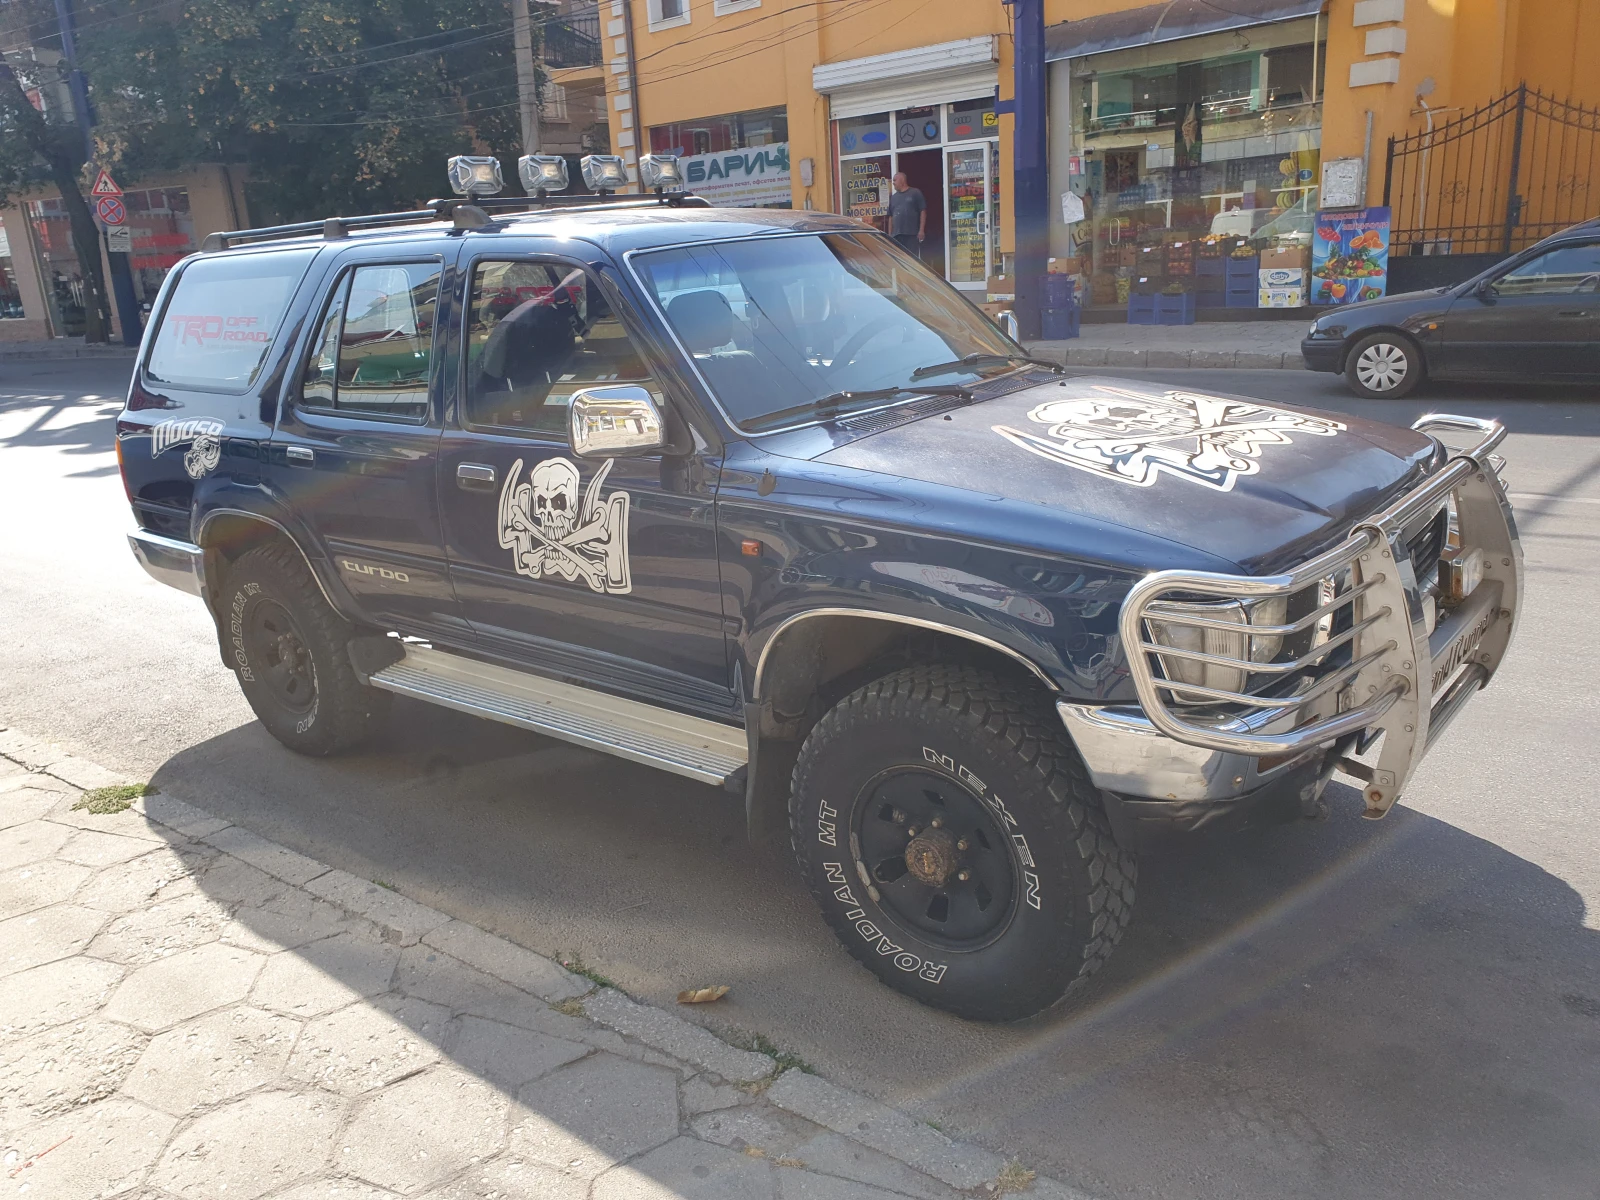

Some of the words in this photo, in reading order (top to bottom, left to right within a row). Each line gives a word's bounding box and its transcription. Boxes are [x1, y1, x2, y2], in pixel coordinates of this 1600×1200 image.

[853, 163, 881, 175] НИВА
[847, 177, 887, 190] САМАРА
[857, 192, 876, 203] ВАЗ
[847, 206, 888, 217] МОСКВИЧ
[169, 314, 223, 345] TRD
[225, 316, 259, 327] OFF
[223, 331, 268, 343] ROAD
[342, 559, 410, 583] turbo
[231, 591, 256, 682] ROADIAN
[244, 582, 262, 598] MT
[818, 799, 838, 847] MT
[922, 746, 1041, 911] NEXEN
[823, 862, 948, 984] ROADIAN
